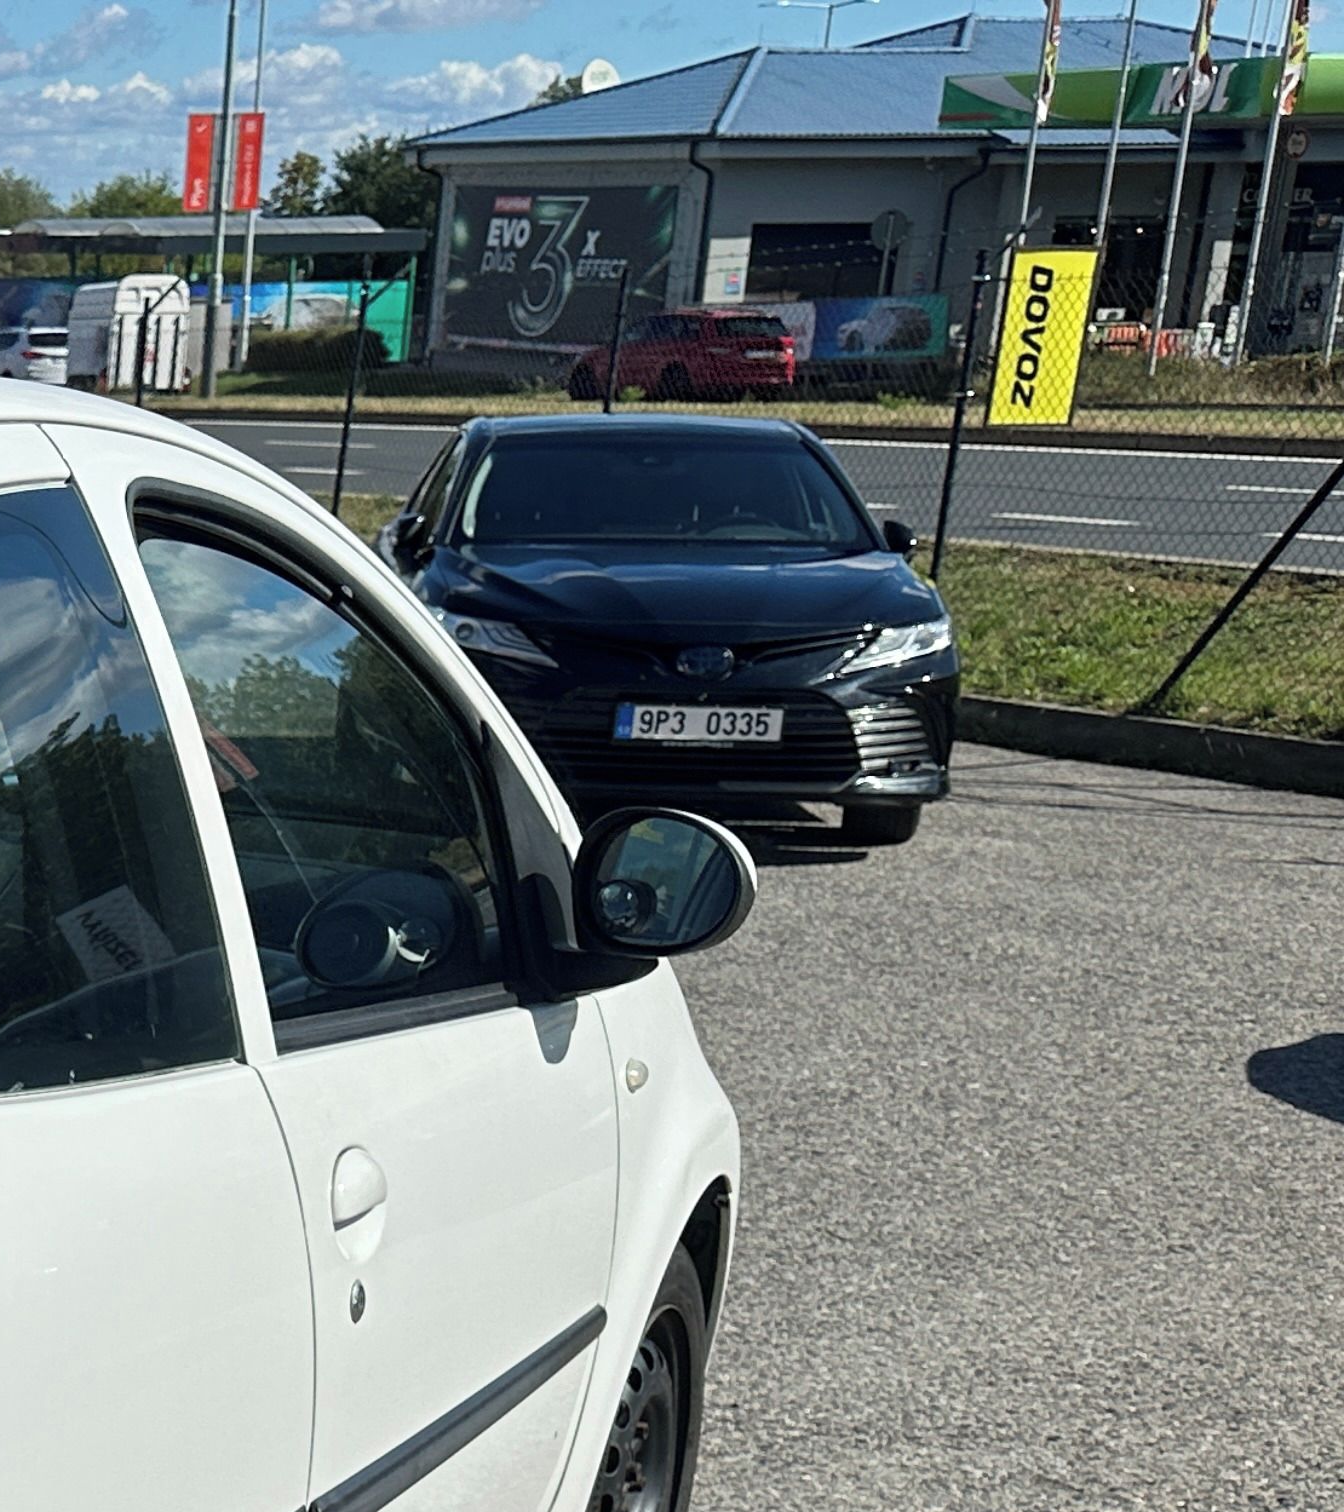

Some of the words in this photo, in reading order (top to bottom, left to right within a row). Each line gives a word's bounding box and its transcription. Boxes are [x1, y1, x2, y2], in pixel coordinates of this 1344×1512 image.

[487, 218, 532, 248] EVO
[479, 248, 517, 275] plus
[575, 258, 629, 279] EFFECT
[1010, 265, 1055, 410] DOVOZ
[639, 710, 687, 736] 9P3
[706, 711, 772, 738] 0335
